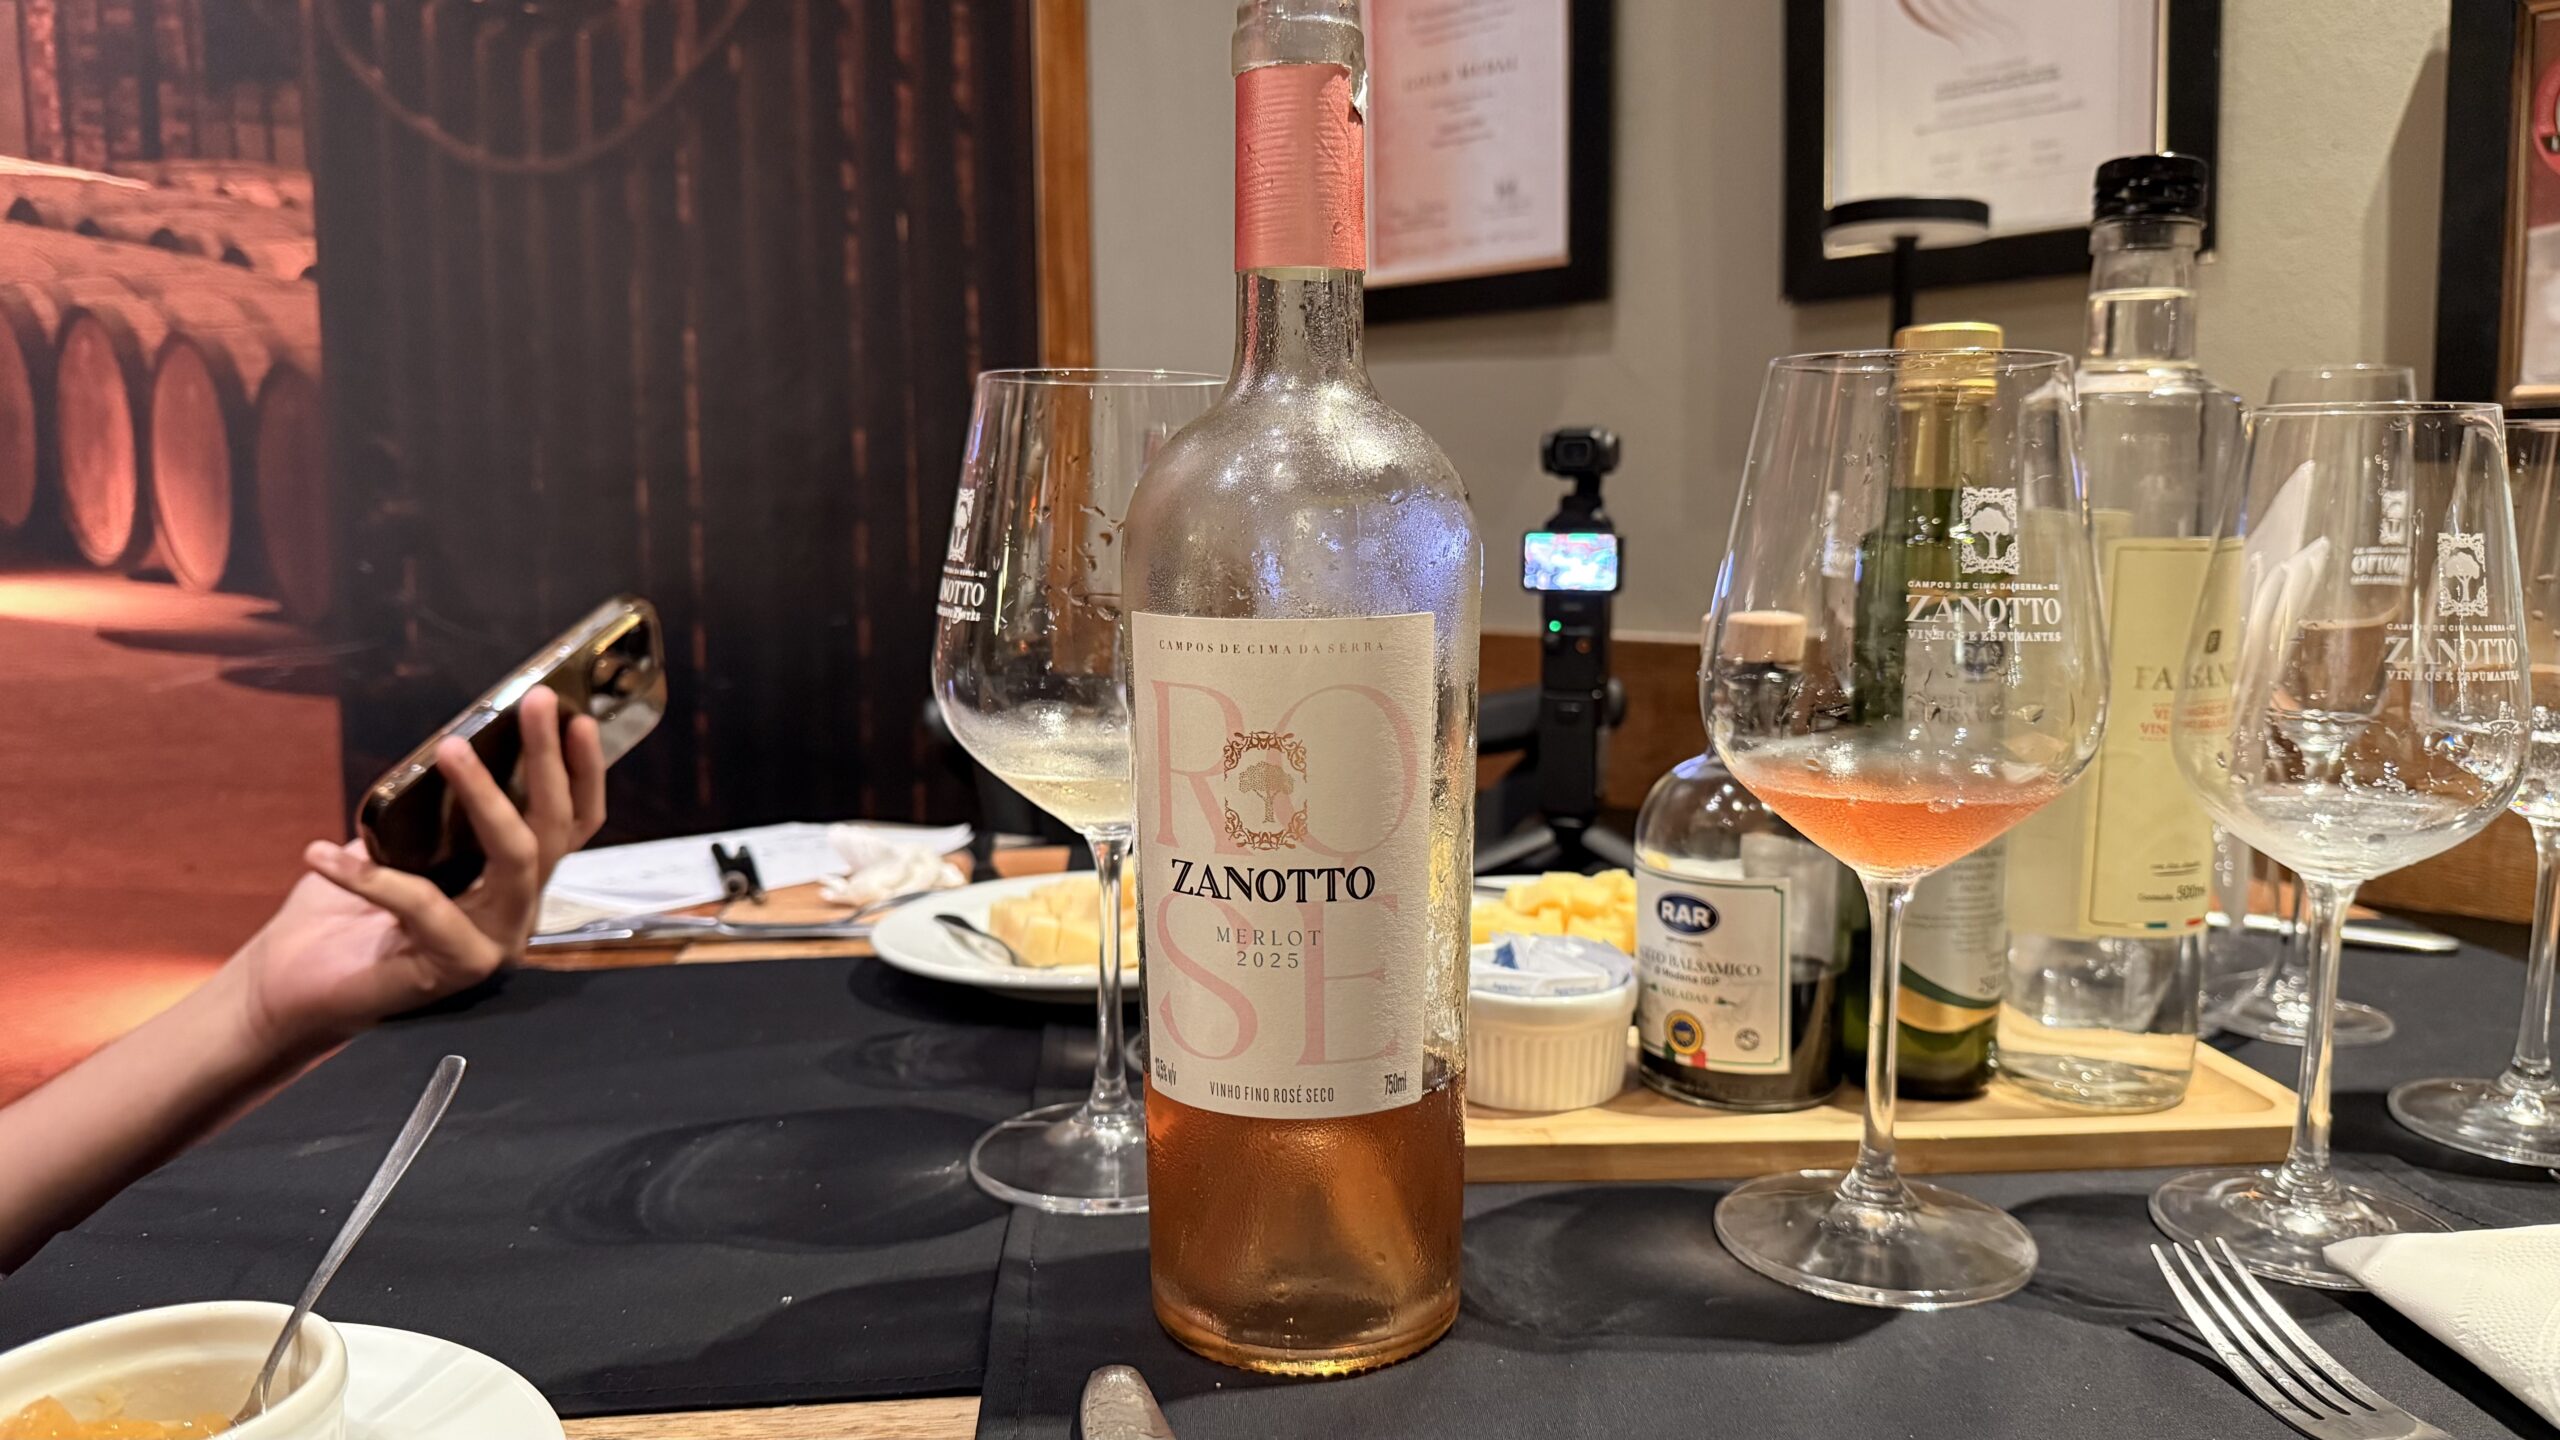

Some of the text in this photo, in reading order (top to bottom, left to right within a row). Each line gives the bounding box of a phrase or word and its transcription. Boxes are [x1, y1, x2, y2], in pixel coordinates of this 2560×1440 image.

[1907, 580, 1951, 589] CAMPOS
[1955, 581, 1969, 589] DE
[1972, 582, 1997, 590] CIMA
[1905, 594, 2062, 625] ZANOTTO
[1907, 629, 2062, 642] VINHOS E ESPUMANTES
[1159, 639, 1385, 656] CAMPOS DE CIMA DA SERRA
[2384, 637, 2519, 665] ZANOTTO
[1171, 858, 1376, 903] ZANOTTO
[1661, 900, 1711, 929] RAR
[1216, 926, 1321, 947] MERLOT
[1236, 951, 1299, 969] 2025
[1668, 953, 1761, 977] BALSAMICO
[1209, 1081, 1335, 1103] VINHO FINO ROSÉ SECO
[1384, 1071, 1407, 1096] 750ml
